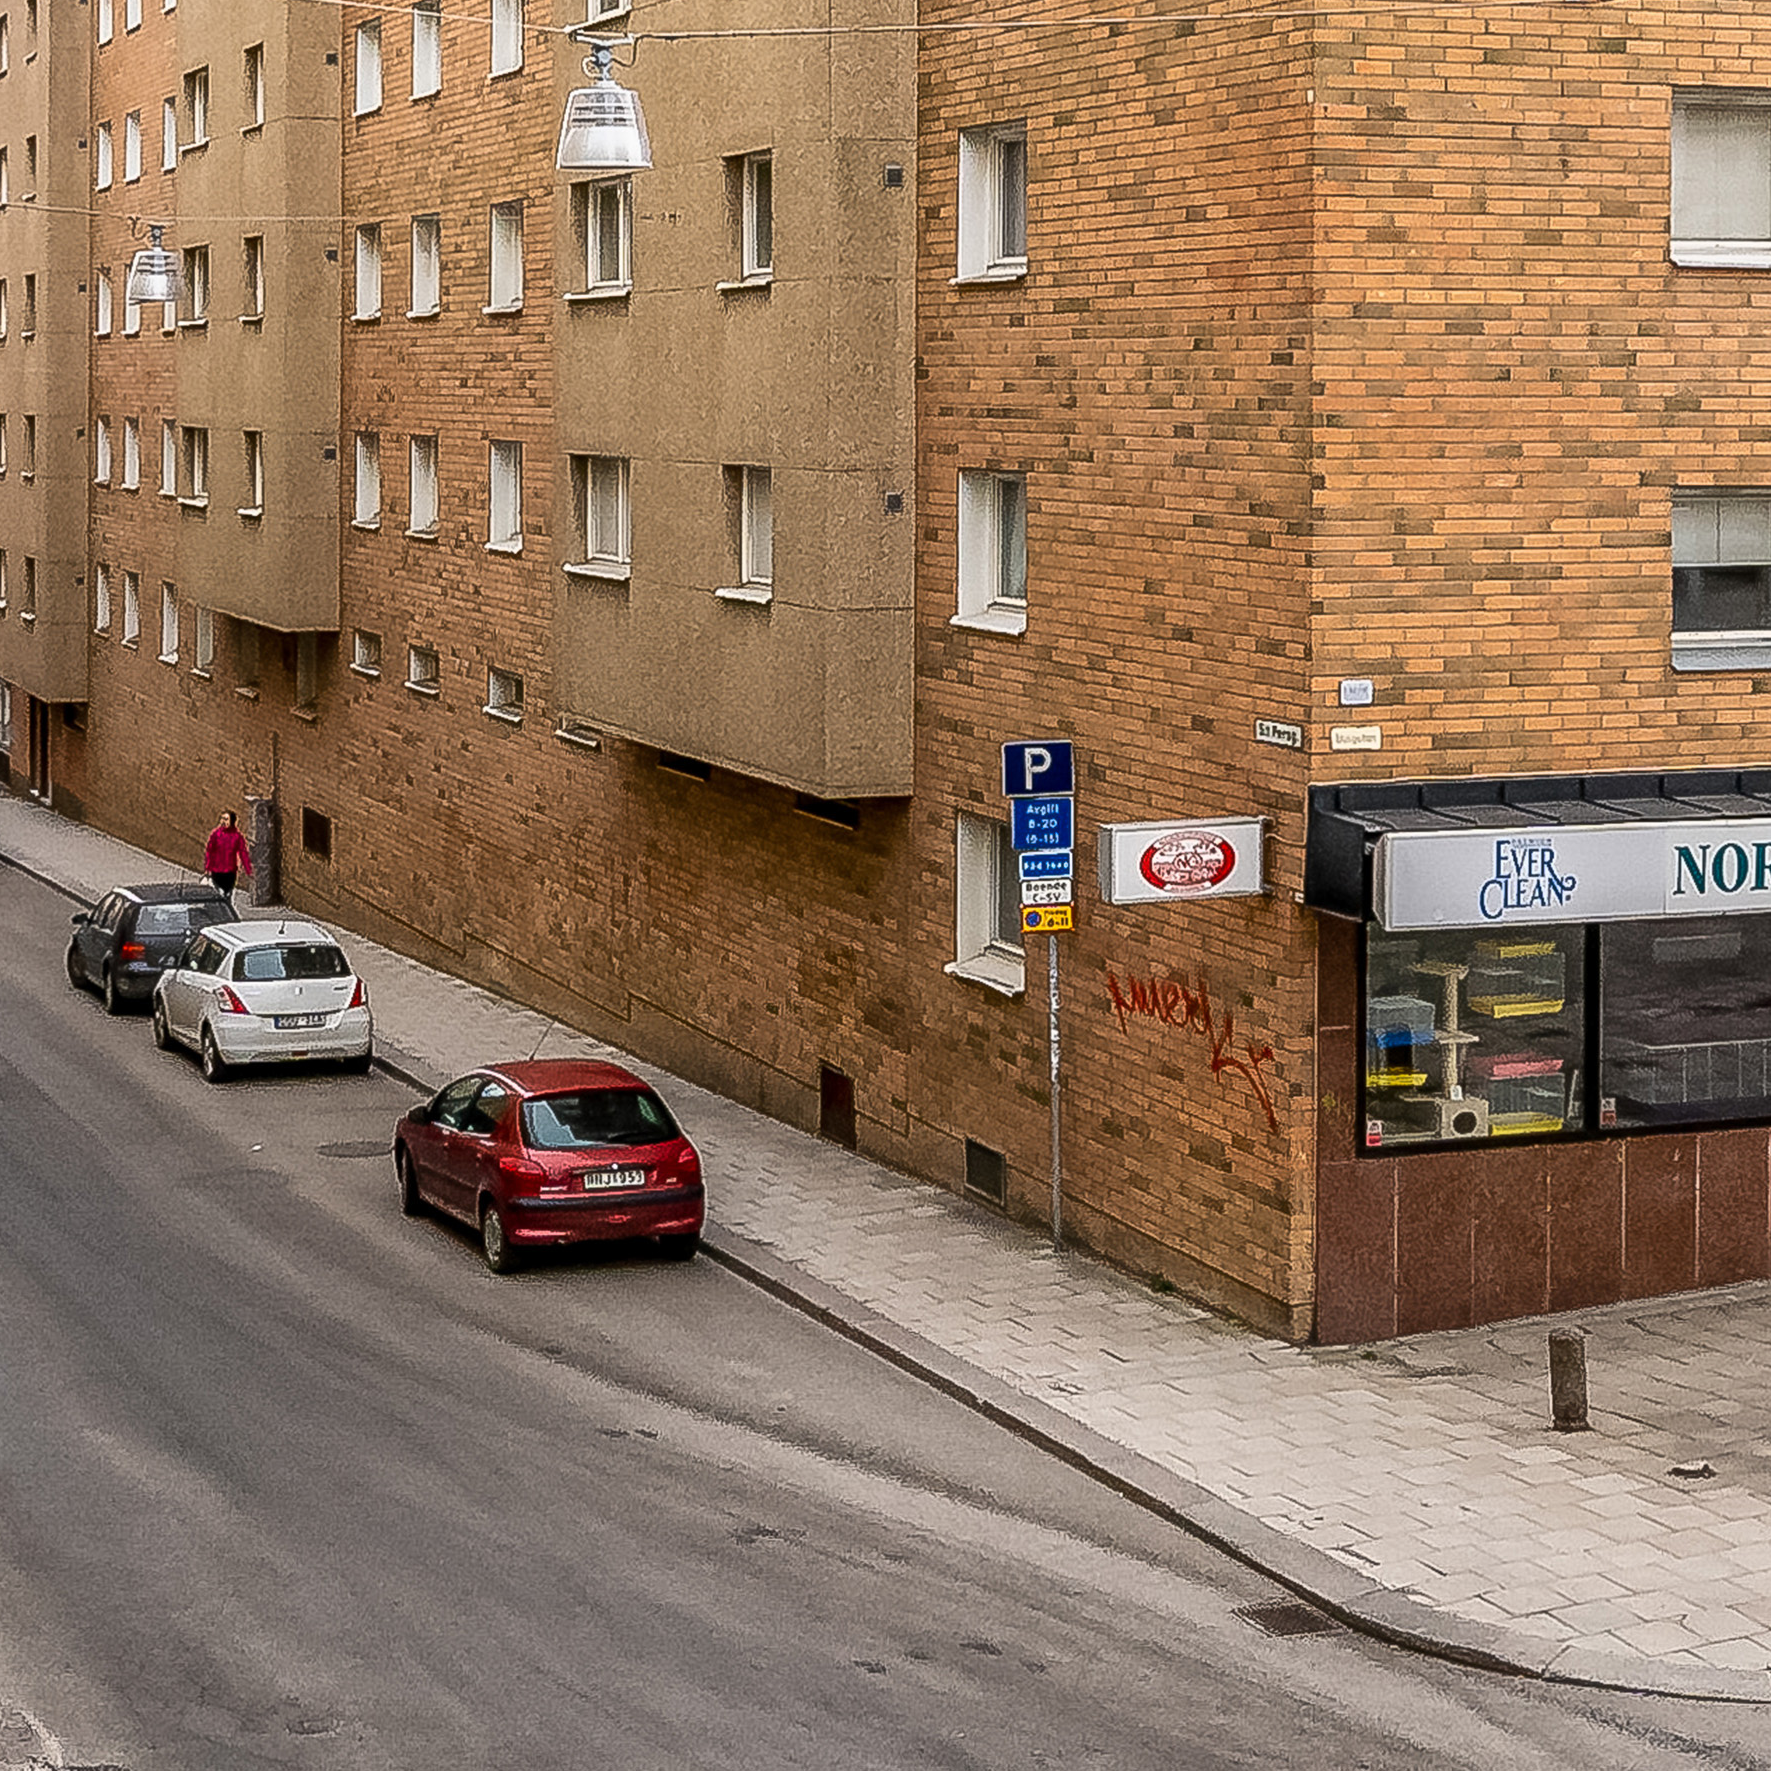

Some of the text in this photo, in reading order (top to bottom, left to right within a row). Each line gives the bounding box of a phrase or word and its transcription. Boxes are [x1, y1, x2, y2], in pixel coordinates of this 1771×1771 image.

[1024, 747, 1052, 790] P
[1495, 840, 1566, 885] EVER
[1480, 878, 1564, 920] CLEAN
